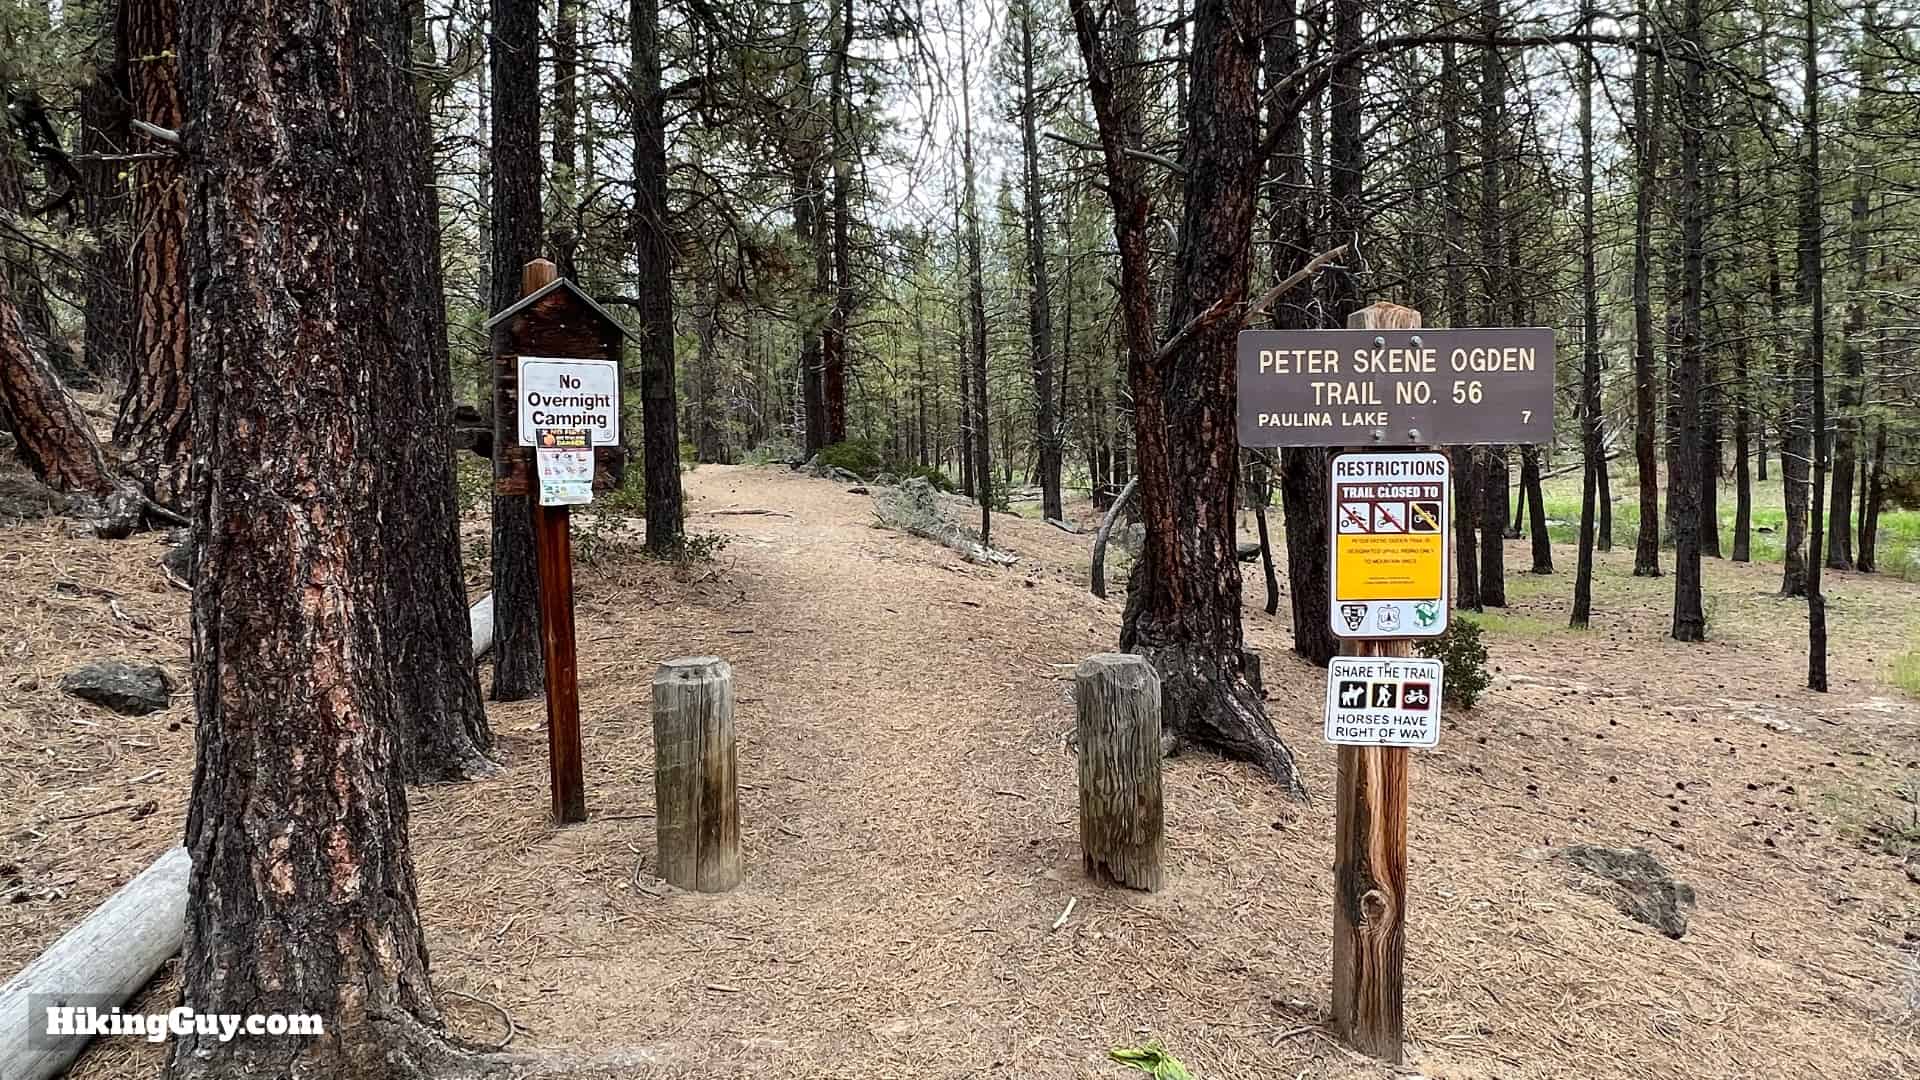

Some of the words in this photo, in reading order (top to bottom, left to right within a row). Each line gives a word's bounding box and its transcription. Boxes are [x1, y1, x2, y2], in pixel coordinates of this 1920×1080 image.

[1259, 349, 1339, 374] PETER
[1353, 348, 1437, 373] SKENE
[1451, 347, 1535, 372] OGDEN
[559, 374, 581, 390] No
[1311, 381, 1382, 406] TRAIL
[1396, 381, 1437, 405] NO.
[1452, 380, 1483, 404] 56
[527, 392, 610, 411] Overnight
[532, 410, 607, 429] Camping
[1258, 412, 1333, 427] PAULINA
[1342, 412, 1388, 426] LAKE
[1521, 410, 1532, 424] 7
[1337, 460, 1445, 477] RESTRICTIONS
[1342, 486, 1375, 498] TRAIL
[1378, 486, 1421, 498] CLOSED
[1424, 486, 1439, 498] TO
[1335, 665, 1373, 678] SHARE
[1378, 666, 1400, 679] THE
[1403, 667, 1436, 679] TRAIL
[1337, 714, 1389, 725] HORSES
[1393, 716, 1428, 726] HAVE
[1336, 726, 1375, 738] RIGHT
[1378, 728, 1396, 738] OF
[1400, 729, 1428, 739] WAY
